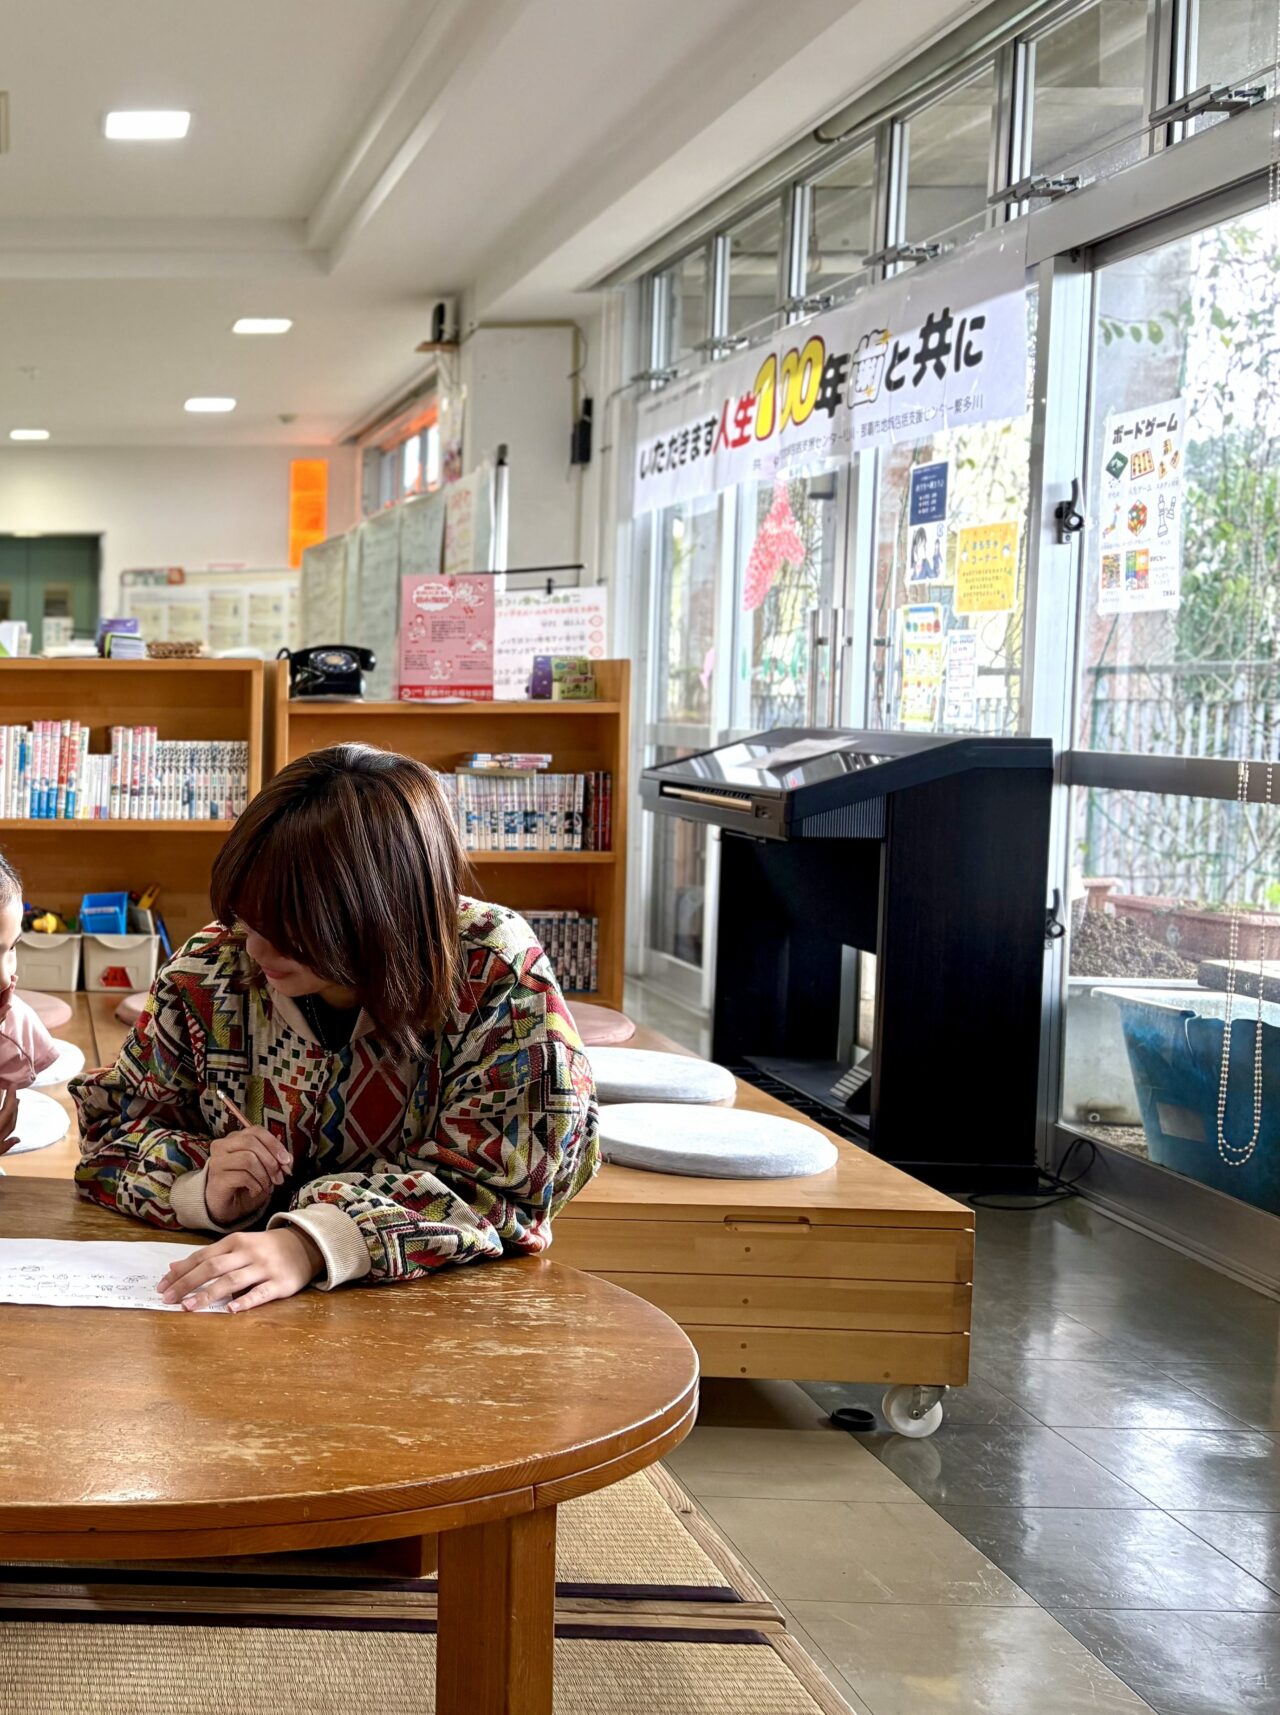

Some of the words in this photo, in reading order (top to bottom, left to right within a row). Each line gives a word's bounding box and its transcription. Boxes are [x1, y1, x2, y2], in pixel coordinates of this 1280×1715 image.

[1112, 413, 1179, 445] ボードゲーム
